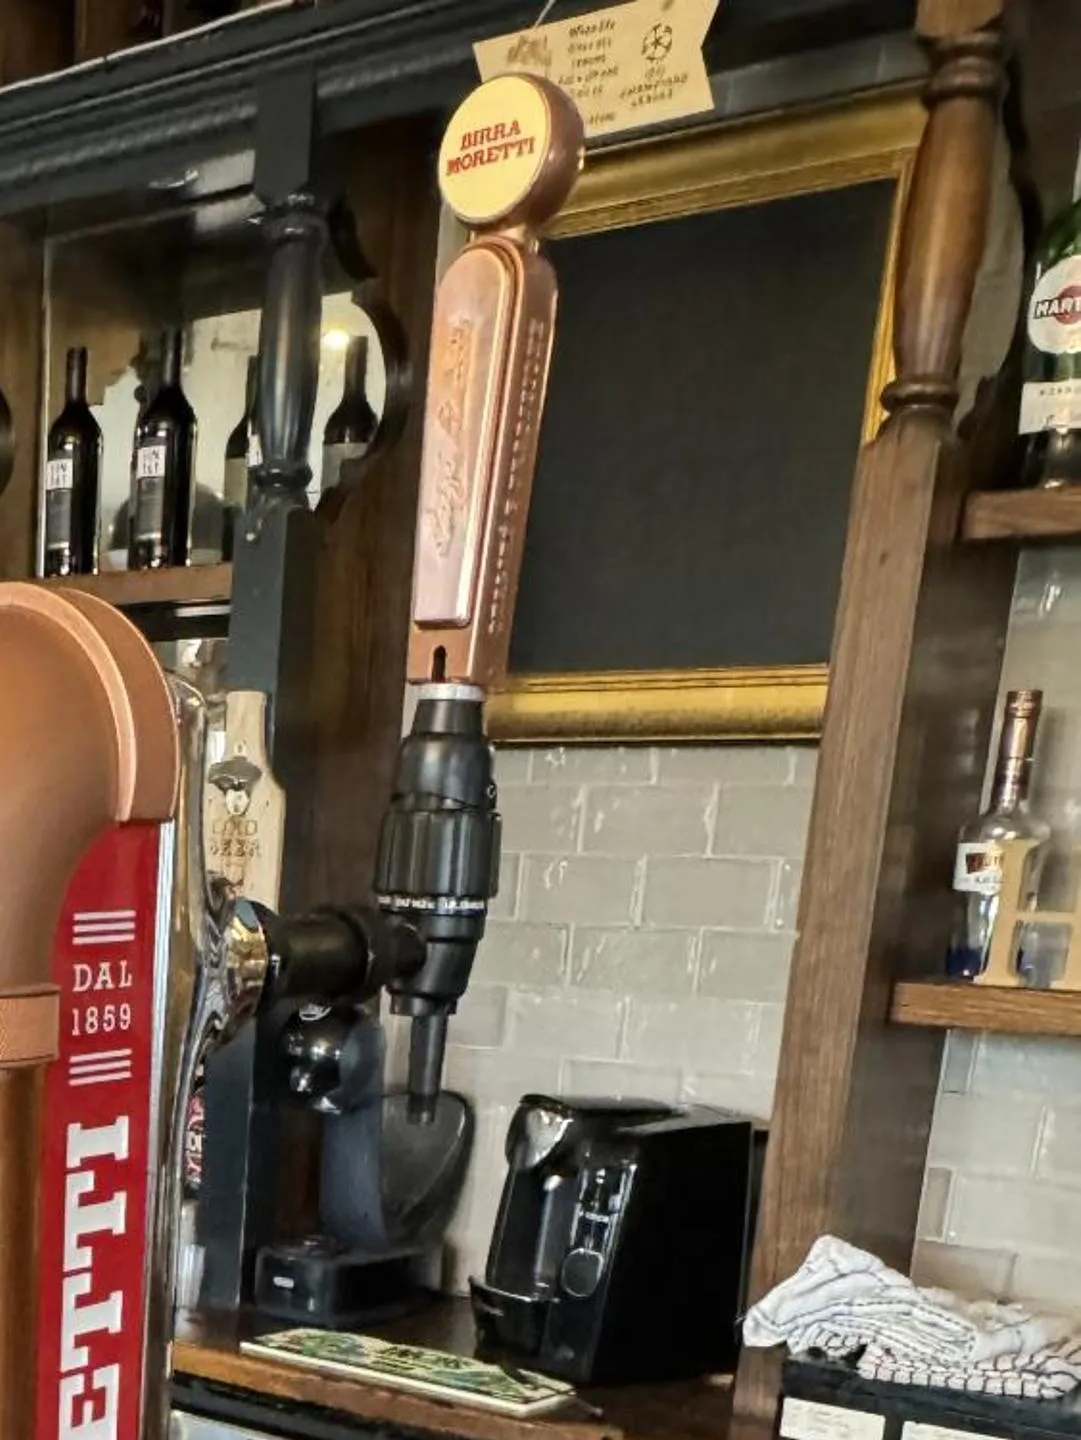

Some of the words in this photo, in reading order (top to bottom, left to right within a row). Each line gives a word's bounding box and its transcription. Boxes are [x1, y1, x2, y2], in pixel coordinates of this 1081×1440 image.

[460, 119, 521, 151] BIRRA
[445, 136, 536, 177] MORETTI
[72, 960, 134, 992] DAL
[71, 1003, 132, 1036] 1859
